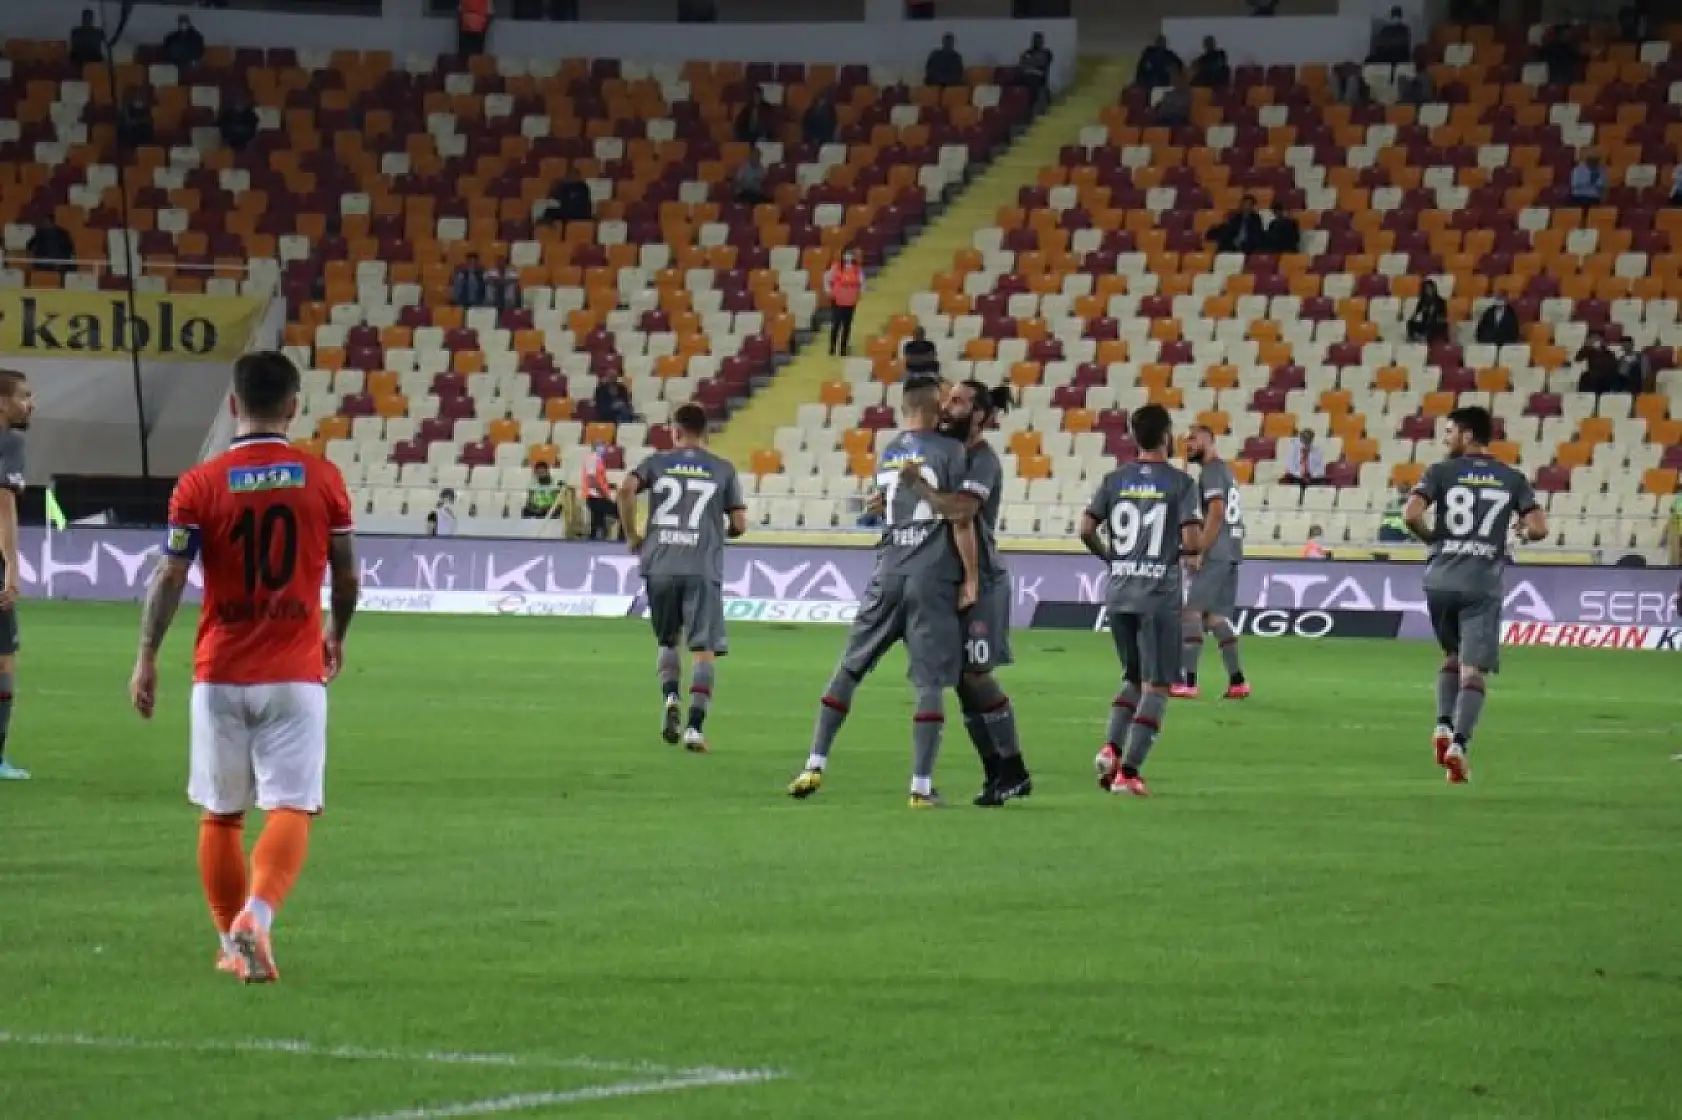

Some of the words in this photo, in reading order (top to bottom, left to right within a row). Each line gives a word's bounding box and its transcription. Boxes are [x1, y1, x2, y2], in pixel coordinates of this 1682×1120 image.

[20, 297, 219, 355] kablo
[652, 476, 718, 530] 27
[1111, 501, 1168, 556] 91
[1444, 486, 1511, 536] 87
[229, 504, 298, 595] 10
[964, 639, 990, 665] 10
[1503, 619, 1649, 648] MERCAN
